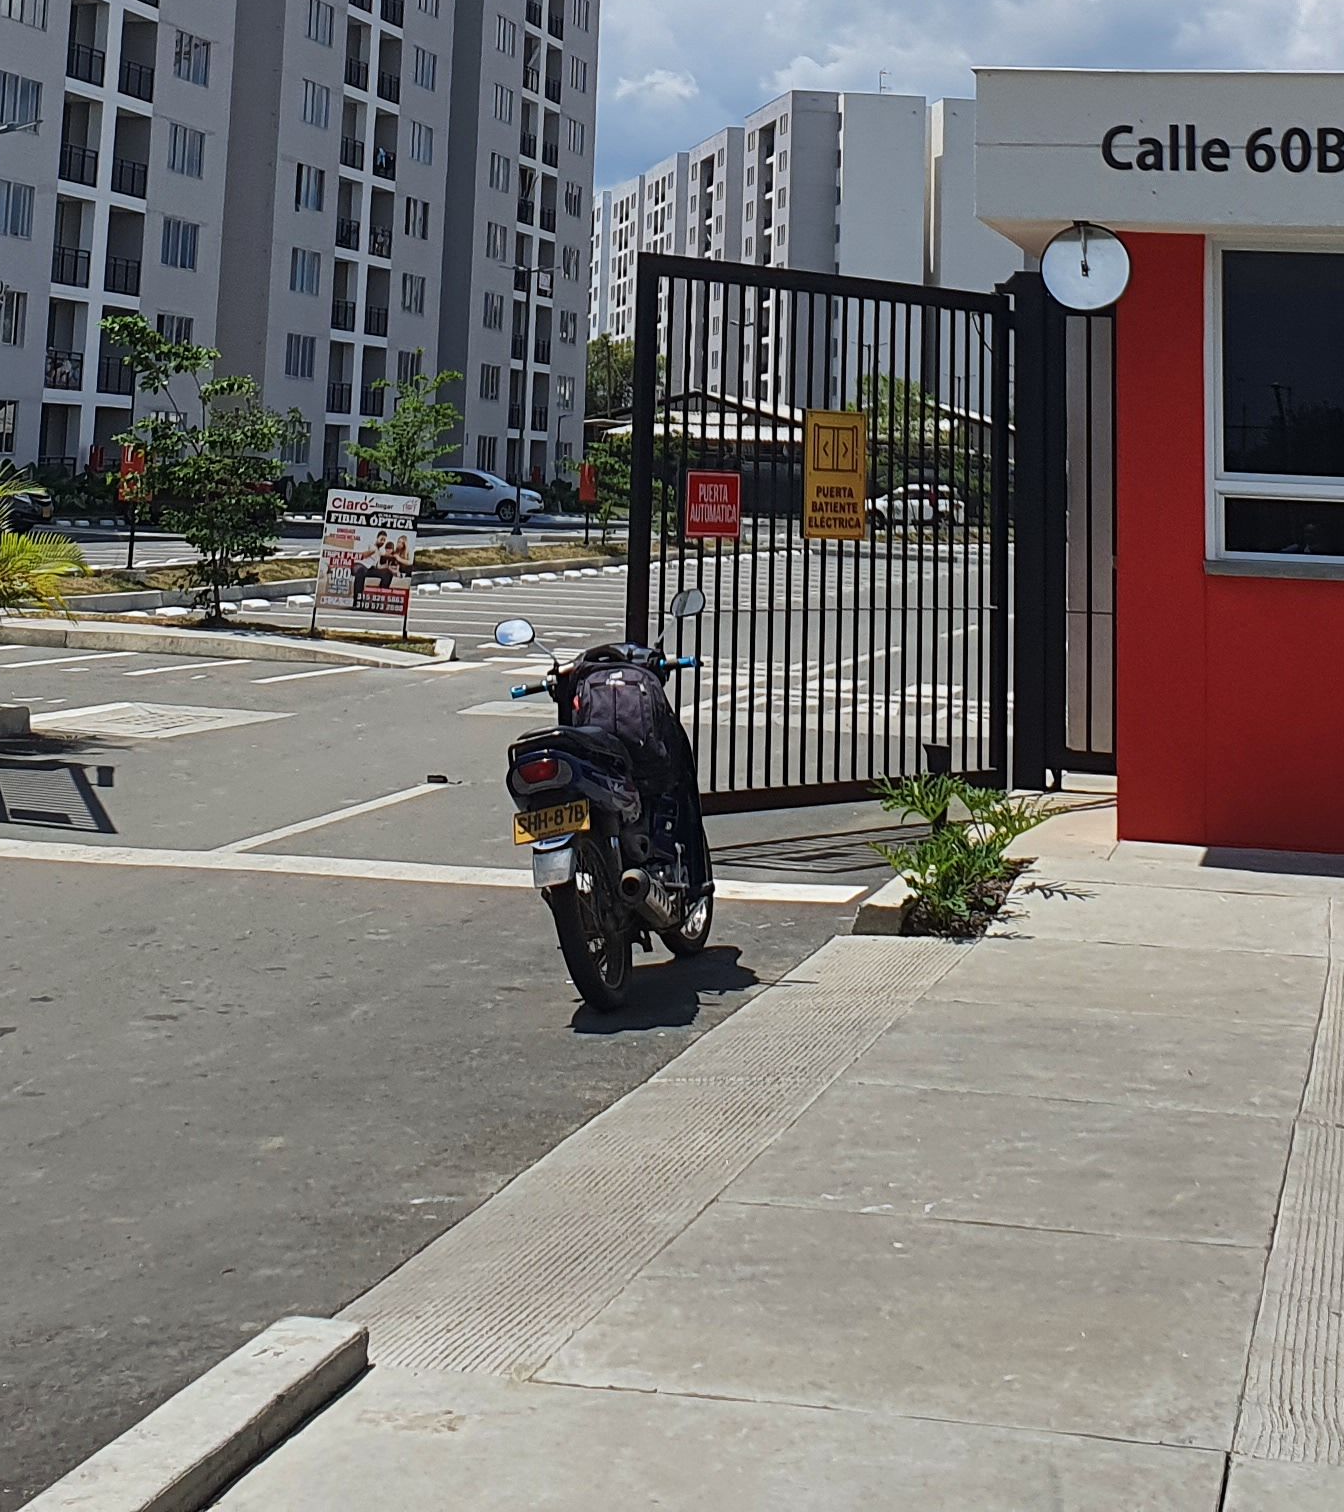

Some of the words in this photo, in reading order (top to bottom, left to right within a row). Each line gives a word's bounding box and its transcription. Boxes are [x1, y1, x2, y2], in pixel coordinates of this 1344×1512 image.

[1101, 124, 1231, 172] Calle
[698, 483, 729, 503] PUERTA
[816, 485, 854, 498] PUERTA
[331, 496, 370, 511] Claro
[811, 500, 858, 514] BATIENTE
[330, 512, 367, 525] FIBRA
[369, 514, 414, 529] ÓPTICA
[689, 503, 737, 524] AUTOMATICA
[324, 550, 346, 559] TRIPLE
[346, 551, 363, 560] PLAY
[330, 568, 351, 579] 100
